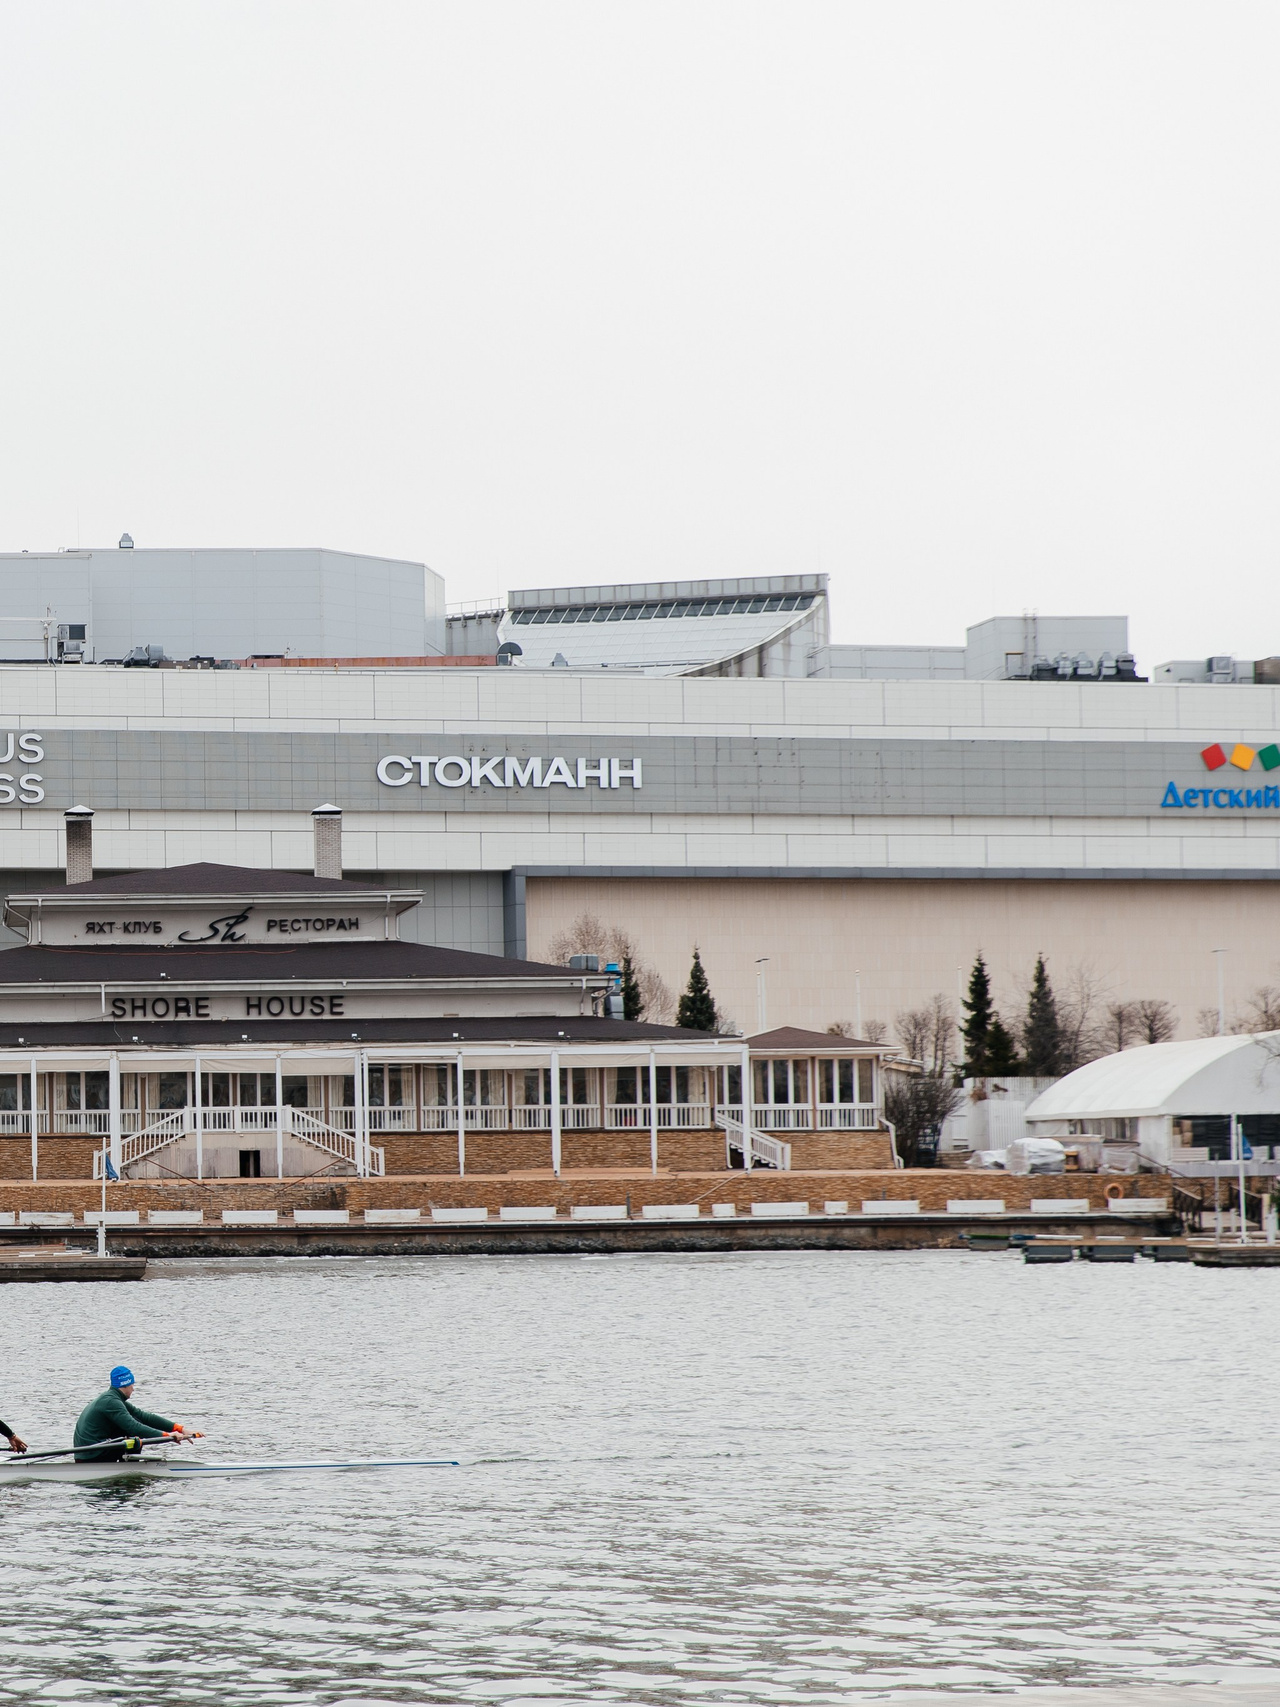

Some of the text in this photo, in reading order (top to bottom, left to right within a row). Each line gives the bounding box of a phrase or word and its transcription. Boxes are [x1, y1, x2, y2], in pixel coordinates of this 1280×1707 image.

[376, 755, 642, 789] СТОКМАНН
[1161, 781, 1280, 809] Детский
[266, 917, 360, 933] РЕСТОРАН
[111, 995, 345, 1019] SHORE HOUSE
